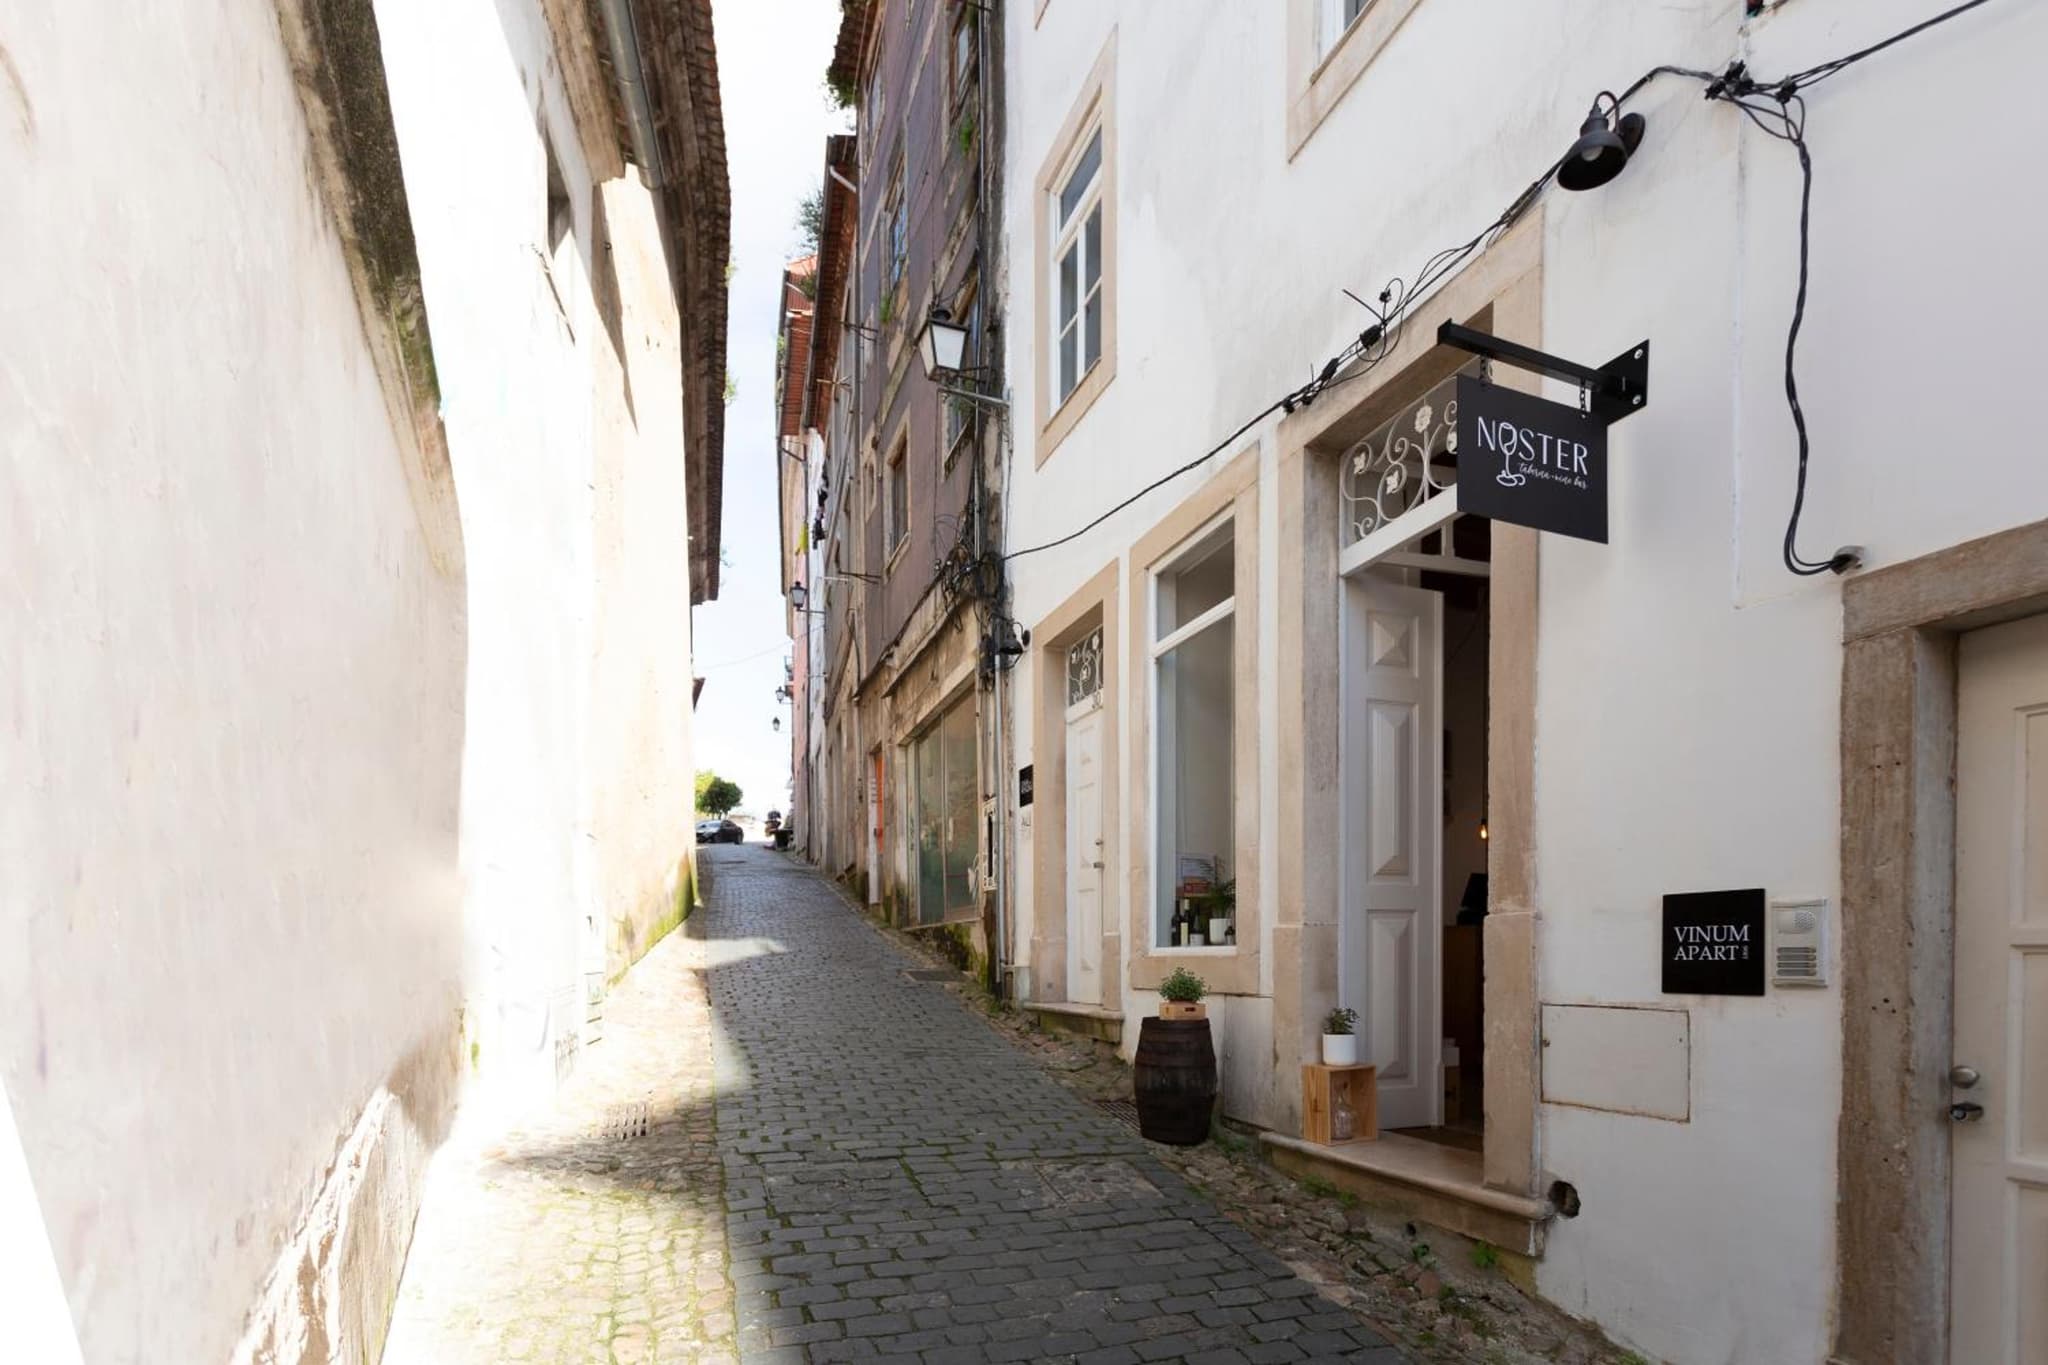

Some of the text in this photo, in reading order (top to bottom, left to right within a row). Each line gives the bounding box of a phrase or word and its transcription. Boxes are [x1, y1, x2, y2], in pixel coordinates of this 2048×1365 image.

[1477, 416, 1588, 476] NOSTER
[1673, 924, 1751, 943] VINUM
[1673, 945, 1740, 961] APART
